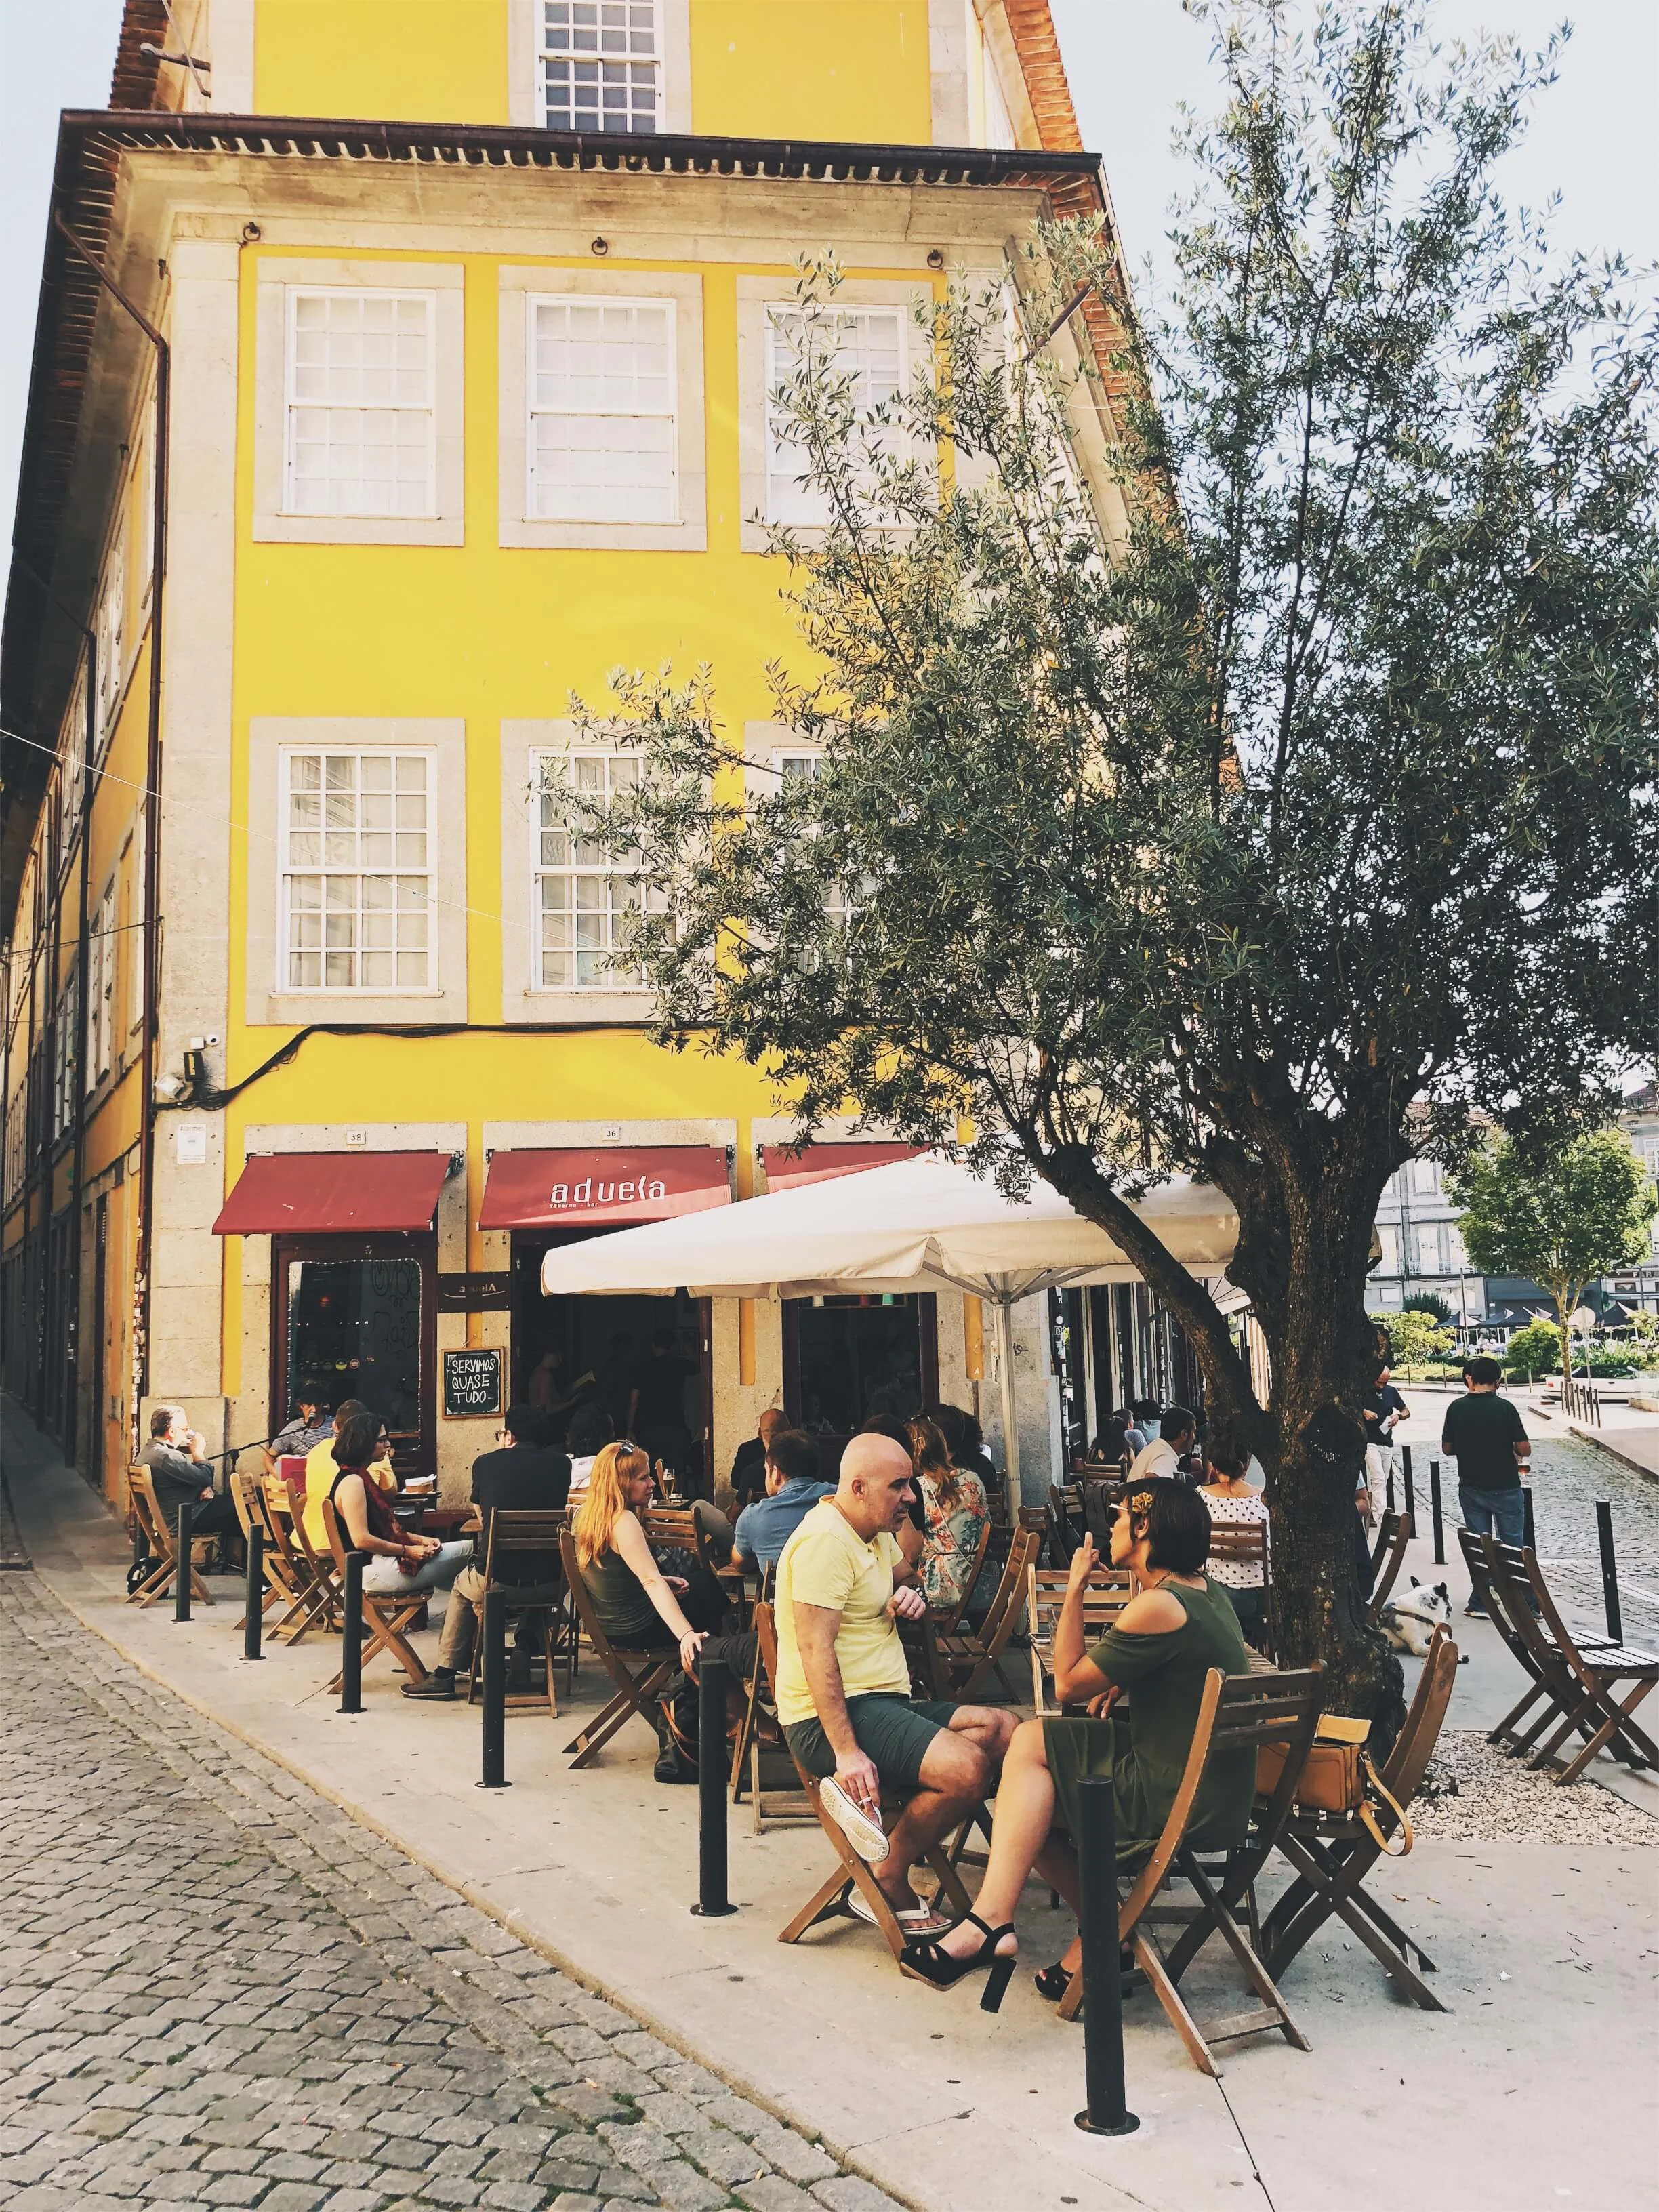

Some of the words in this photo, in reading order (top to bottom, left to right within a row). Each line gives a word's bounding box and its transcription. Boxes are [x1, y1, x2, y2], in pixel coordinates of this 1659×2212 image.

[351, 1133, 361, 1141] 38
[550, 1175, 666, 1204] aduela
[451, 1357, 496, 1374] SERVIMOS
[451, 1374, 491, 1391] QUASE
[453, 1390, 487, 1404] TUDO
